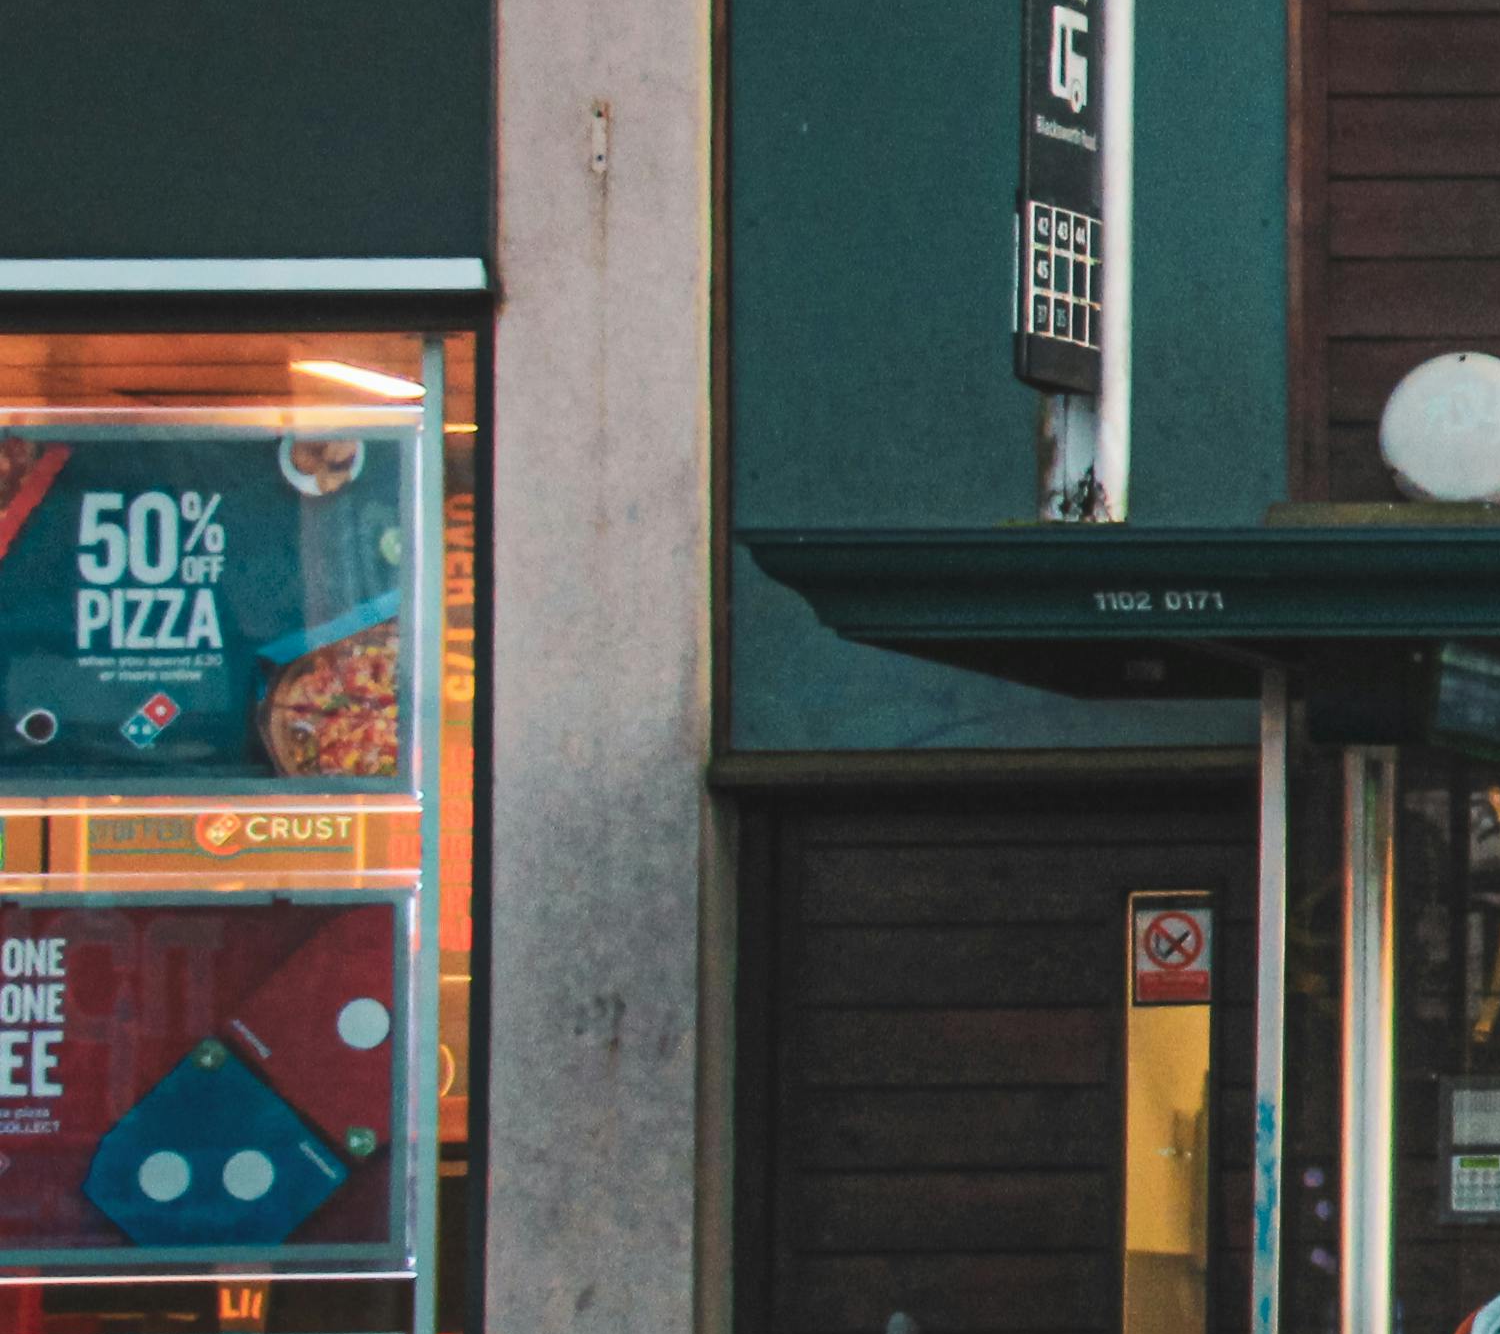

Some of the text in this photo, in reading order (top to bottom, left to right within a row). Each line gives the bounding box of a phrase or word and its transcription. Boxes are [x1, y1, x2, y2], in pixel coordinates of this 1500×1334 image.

[77, 491, 226, 585] 50%
[181, 554, 226, 584] OFF
[77, 588, 223, 650] PIZZA
[1093, 590, 1225, 611] 1102 0171
[245, 816, 352, 841] CRUST
[2, 938, 67, 977] ONE
[0, 983, 66, 1024] ONE
